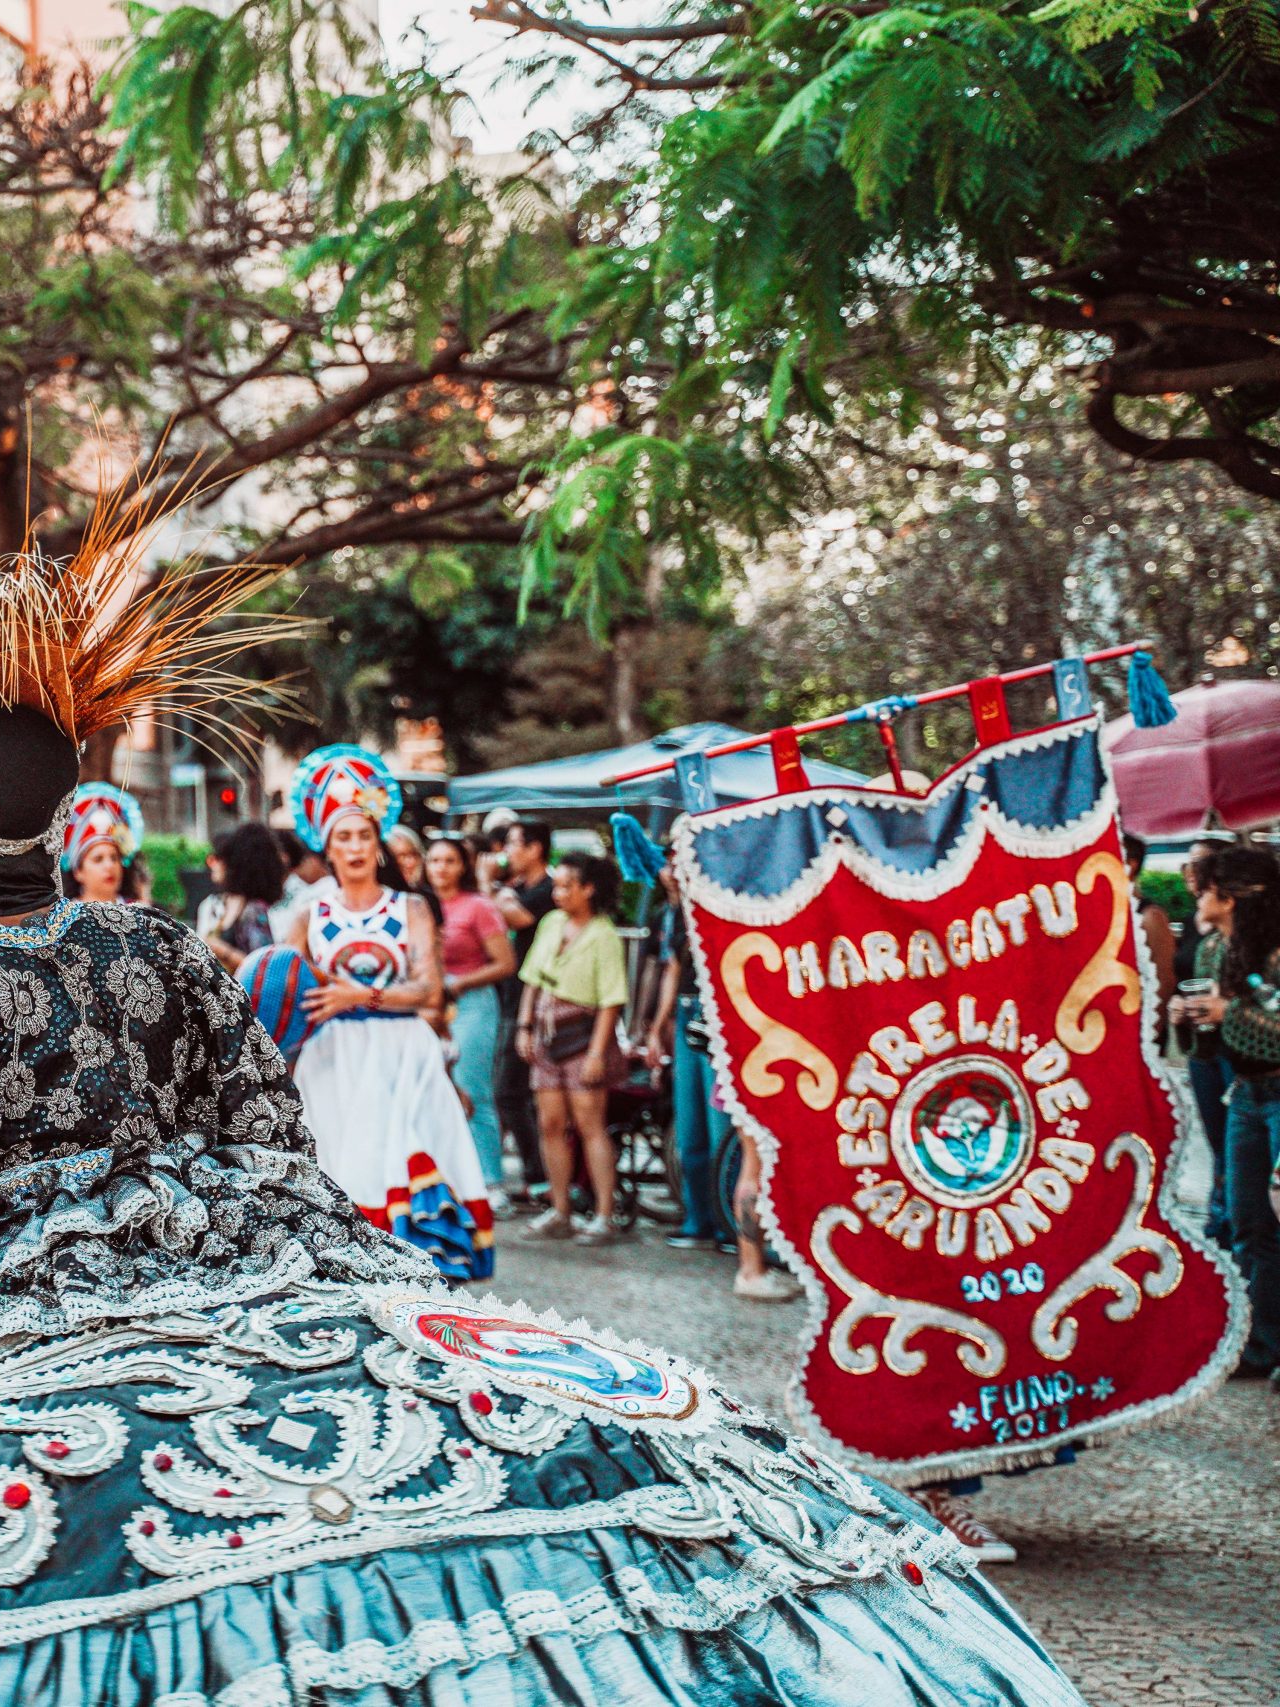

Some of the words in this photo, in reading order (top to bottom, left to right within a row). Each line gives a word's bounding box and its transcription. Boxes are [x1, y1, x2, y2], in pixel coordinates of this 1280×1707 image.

[836, 994, 1022, 1168] ESTRELA
[1022, 1037, 1092, 1124] DE
[852, 1137, 1097, 1263] ARUANDA
[960, 1262, 1046, 1304] 2020
